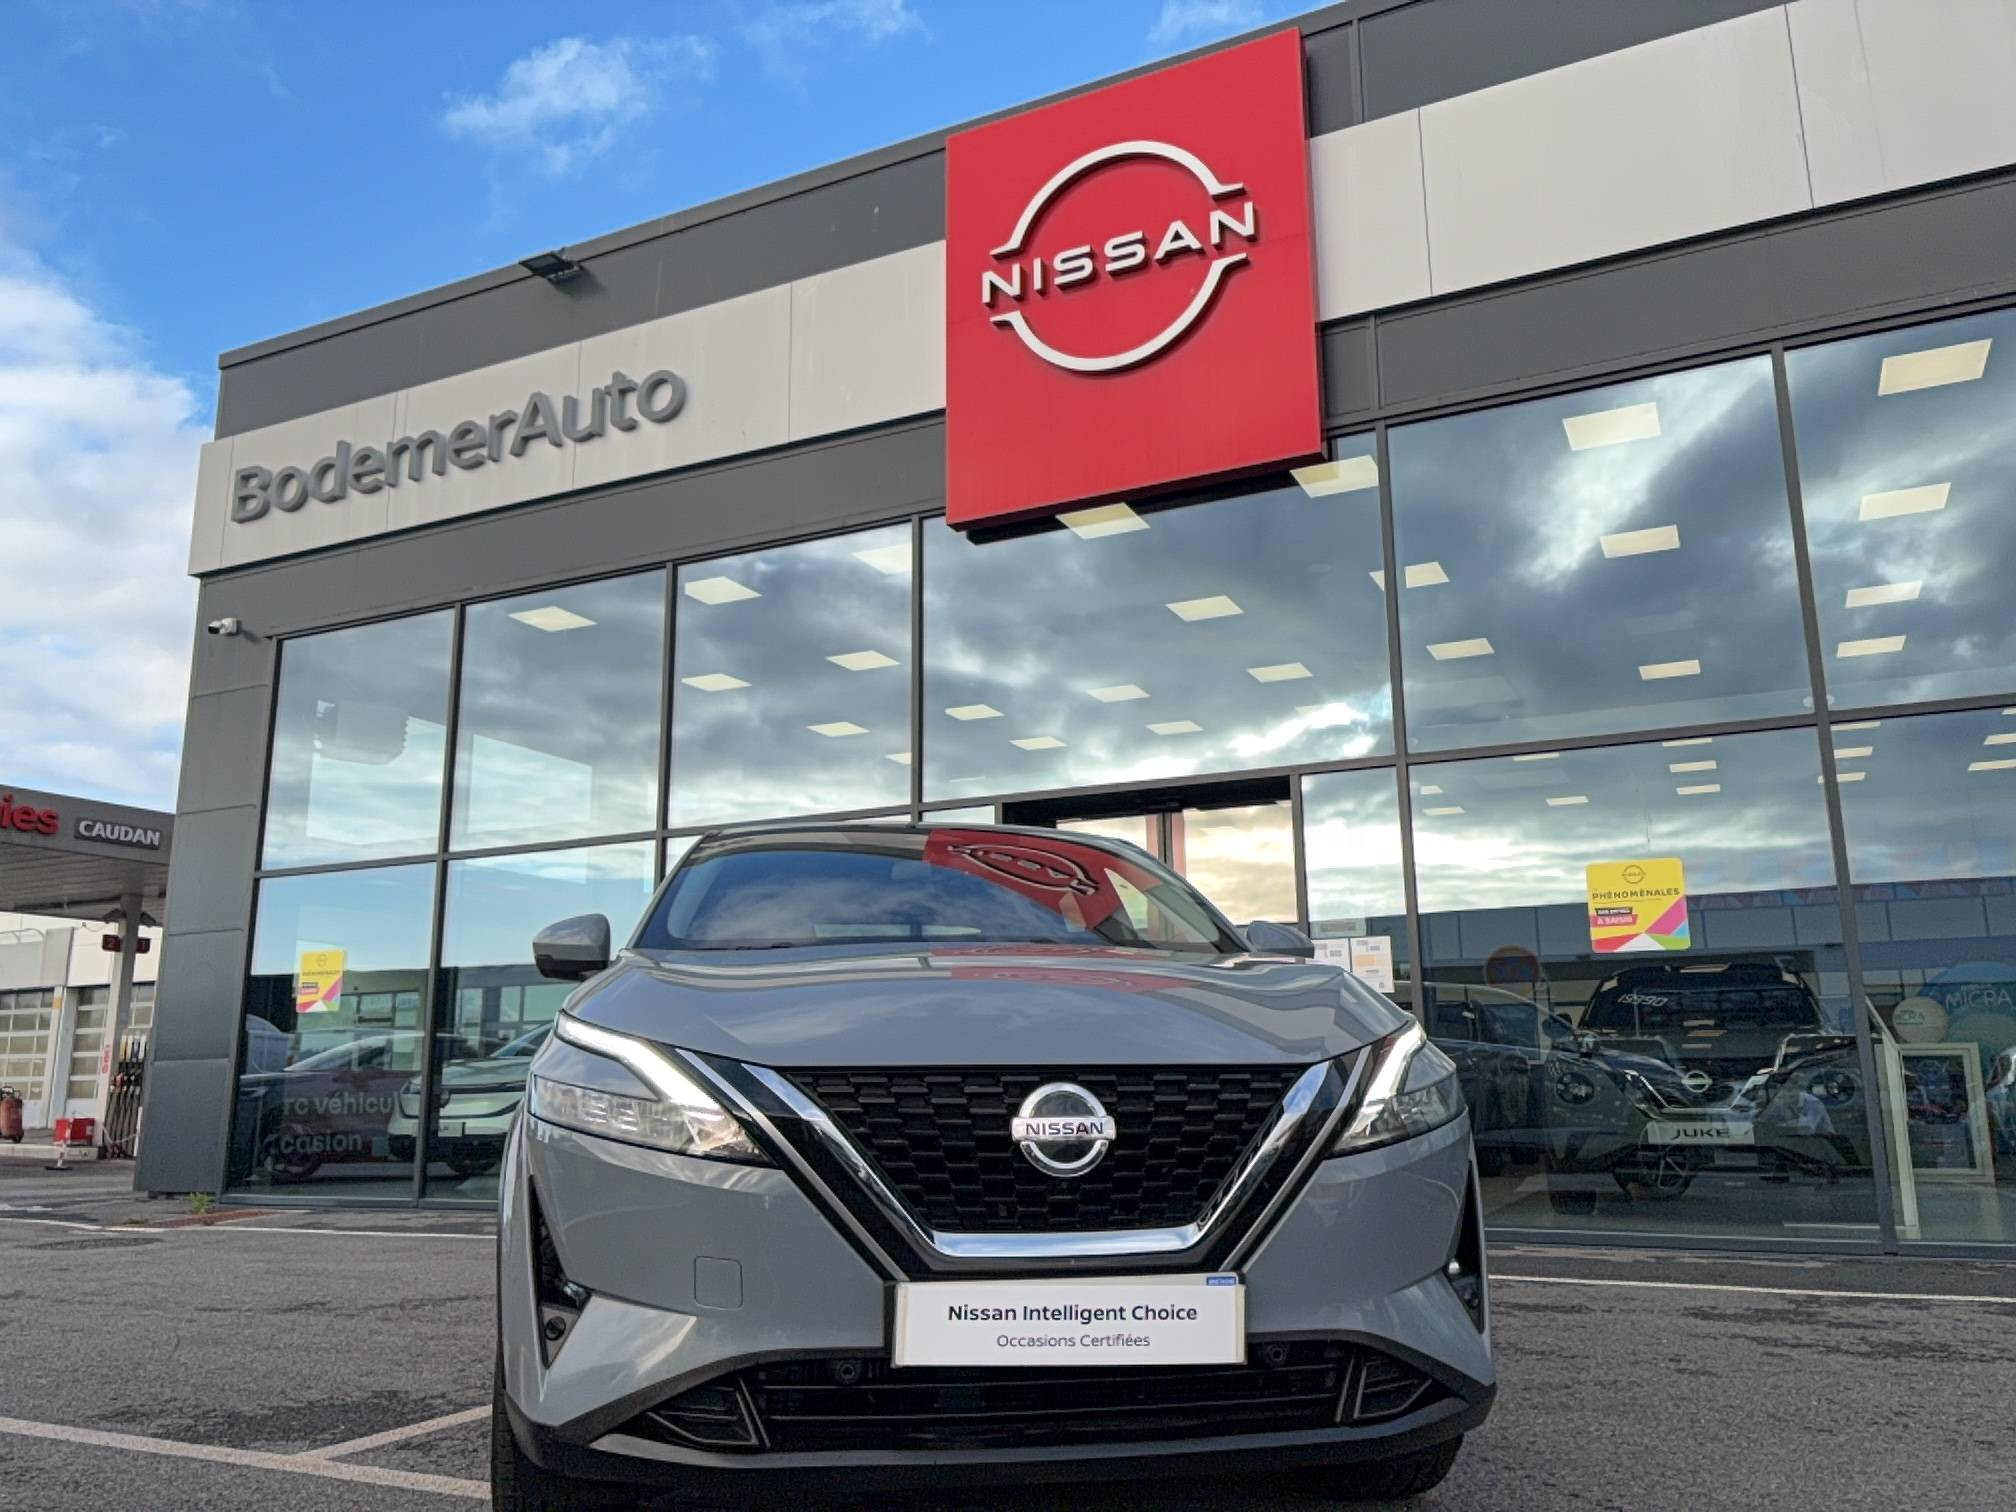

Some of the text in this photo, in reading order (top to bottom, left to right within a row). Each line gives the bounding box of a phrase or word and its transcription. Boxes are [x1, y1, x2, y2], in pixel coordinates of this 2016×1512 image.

[981, 201, 1257, 308] NISSAN
[231, 369, 686, 524] BodemerAuto
[0, 792, 59, 835] ies
[79, 820, 160, 846] CAUDAN
[1945, 989, 2012, 1010] MICRA
[314, 1091, 392, 1115] véhicu
[1025, 1121, 1103, 1136] NISSAN
[1671, 1127, 1730, 1140] JUKE
[280, 1130, 362, 1153] casion
[947, 1303, 1198, 1325] Nissan Intelligent Choice
[996, 1332, 1151, 1347] Occasions Certifiées
